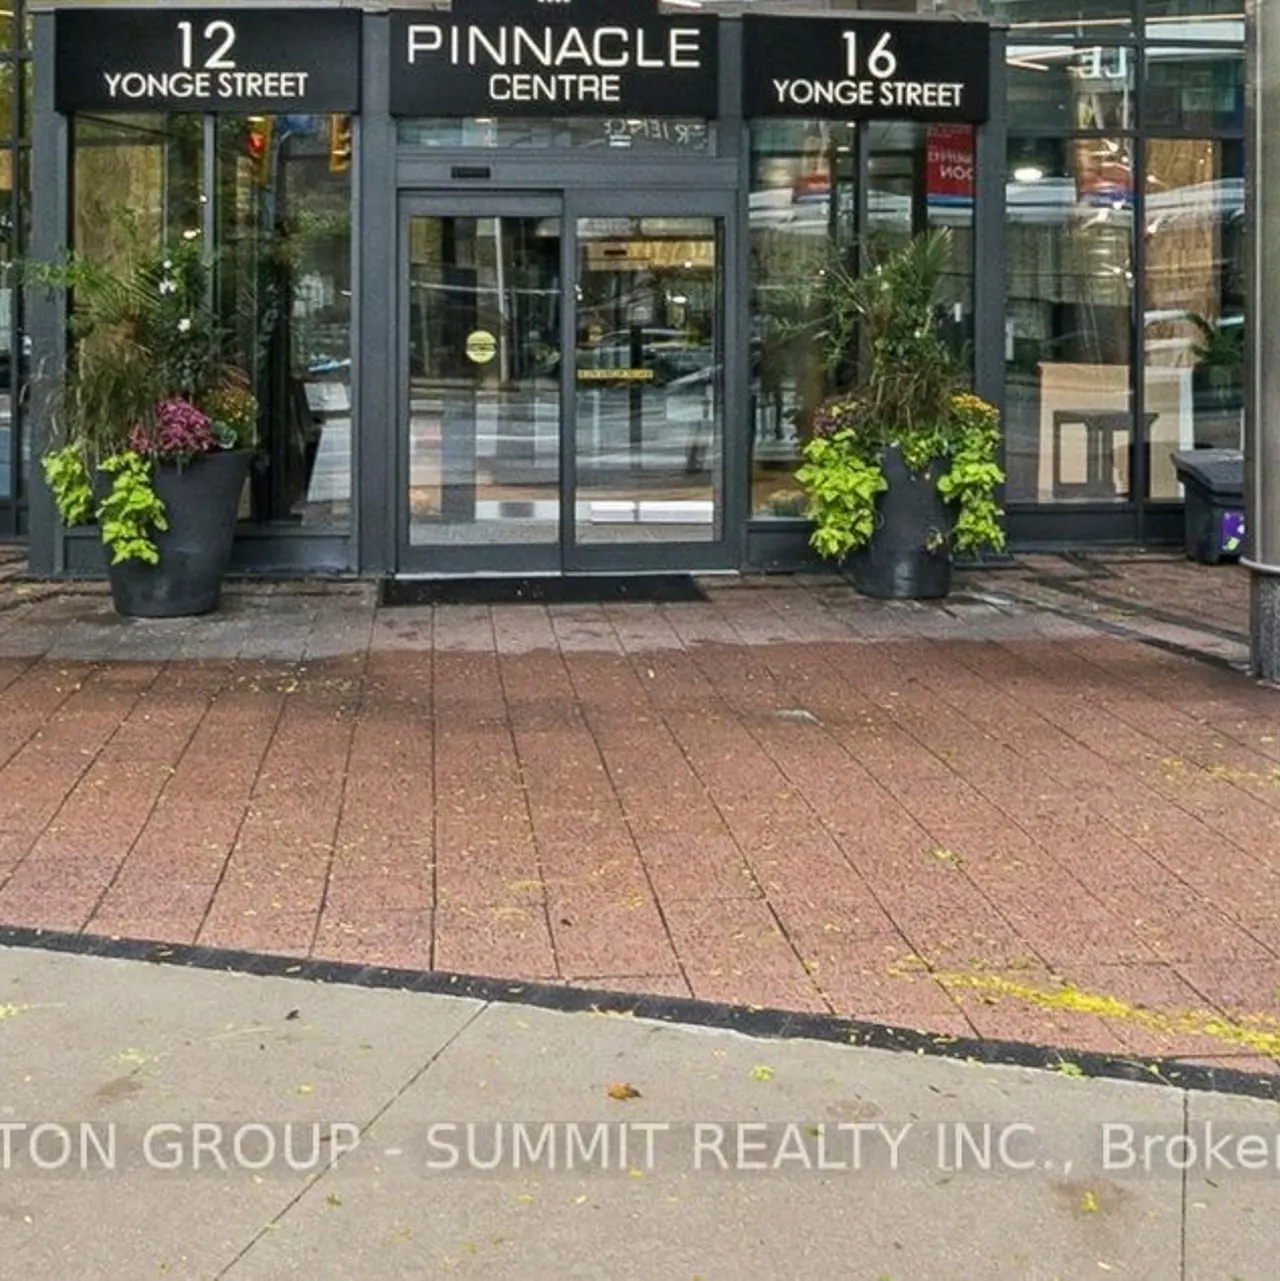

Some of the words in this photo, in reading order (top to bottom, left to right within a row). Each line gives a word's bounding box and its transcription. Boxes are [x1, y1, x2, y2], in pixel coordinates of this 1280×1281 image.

[177, 20, 236, 69] 12
[407, 24, 701, 68] PINNACLE
[842, 30, 897, 79] 16
[104, 71, 211, 99] YONGE
[218, 71, 309, 99] STREET
[489, 73, 620, 102] CENTRE
[773, 80, 873, 107] YONGE
[879, 80, 964, 108] STREET
